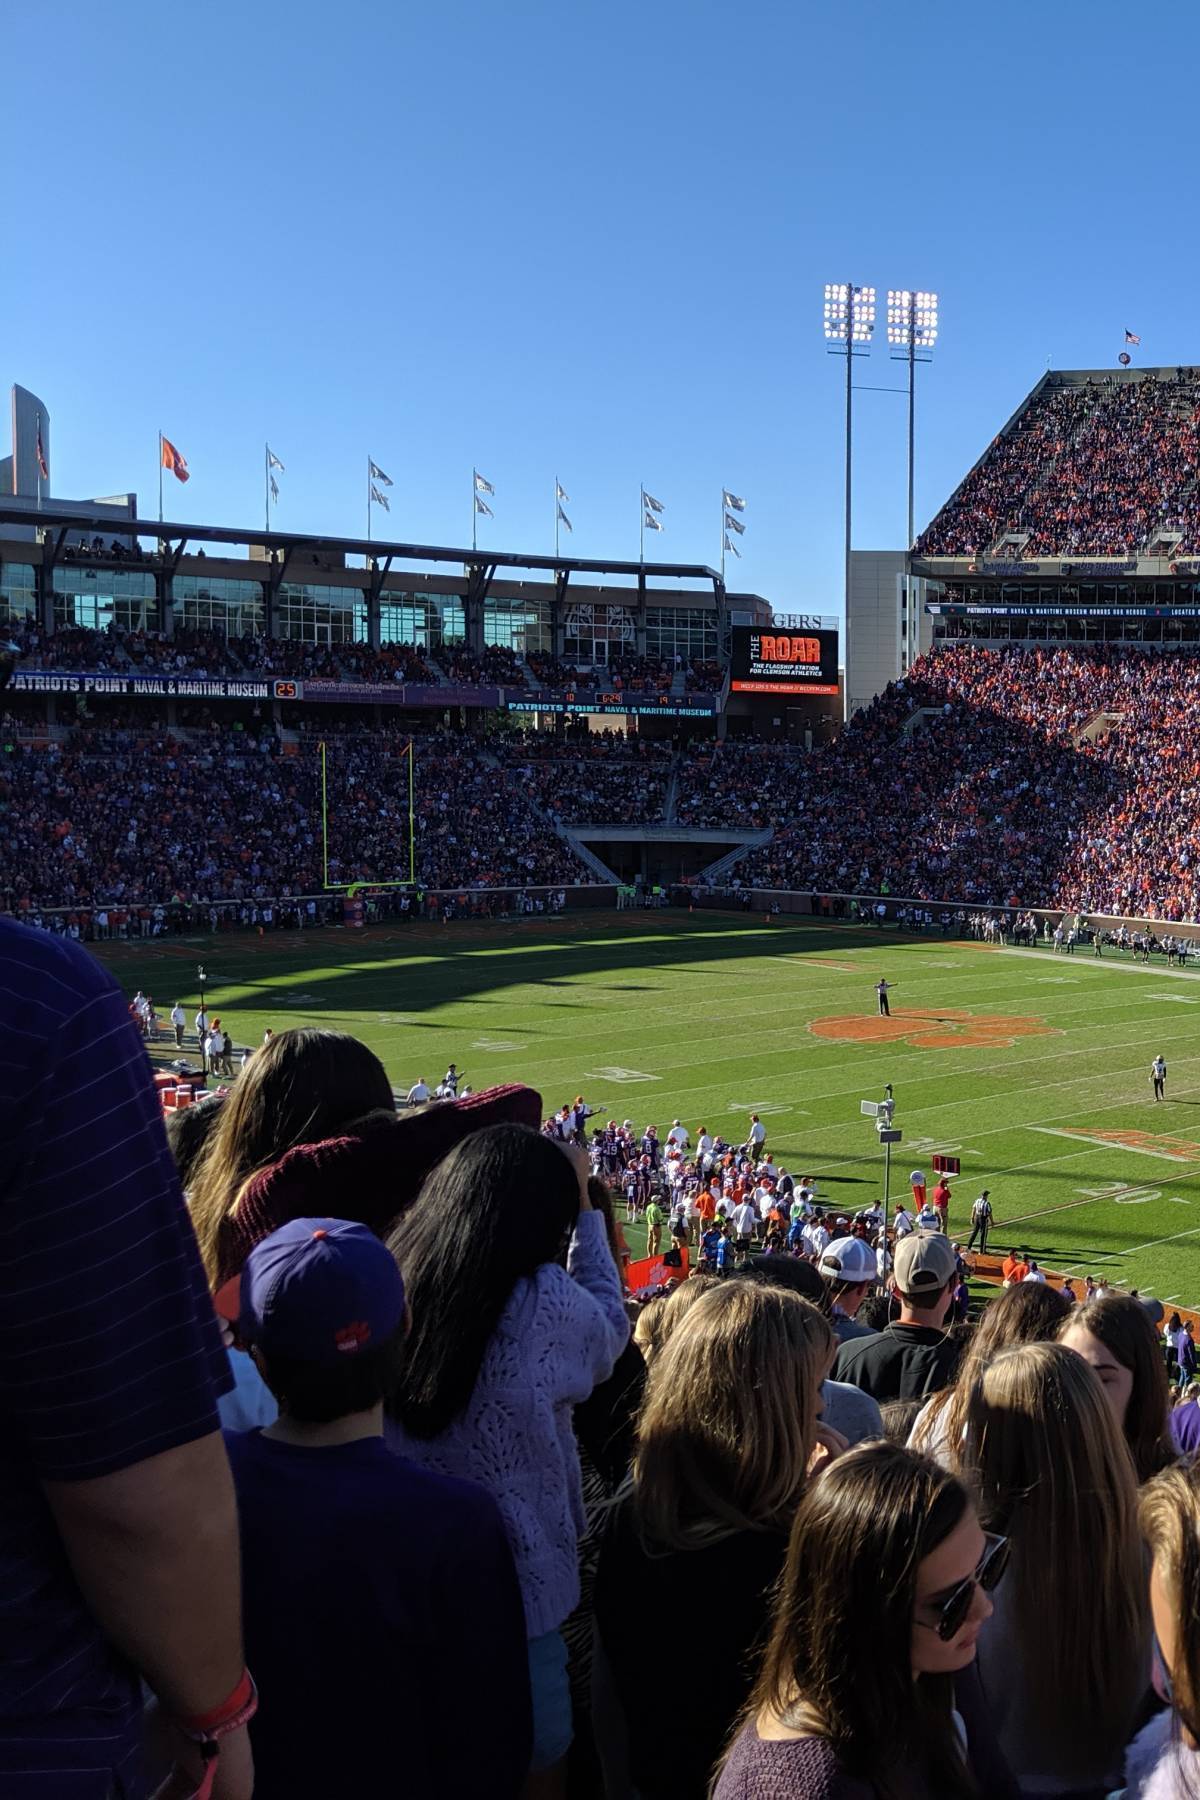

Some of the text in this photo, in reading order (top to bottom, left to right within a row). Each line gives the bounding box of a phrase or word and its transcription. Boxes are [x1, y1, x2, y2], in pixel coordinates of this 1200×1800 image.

[966, 607, 991, 615] PATRIOTS
[992, 607, 1008, 615] POINT
[1010, 607, 1028, 615] NAVAL
[750, 635, 759, 660] THE
[760, 635, 820, 662] ROAR
[5, 674, 268, 697] PATRIOTS POINT NAVAL & MARITIME MUSEUM
[277, 684, 296, 696] 25
[566, 692, 574, 702] 10
[602, 694, 621, 703] 6:29
[659, 696, 668, 704] 19
[508, 702, 563, 712] PATRIOTS
[567, 703, 601, 713] POINT
[604, 705, 629, 714] NAVAL
[639, 706, 677, 716] MARITIME
[679, 708, 712, 717] MUSEUM
